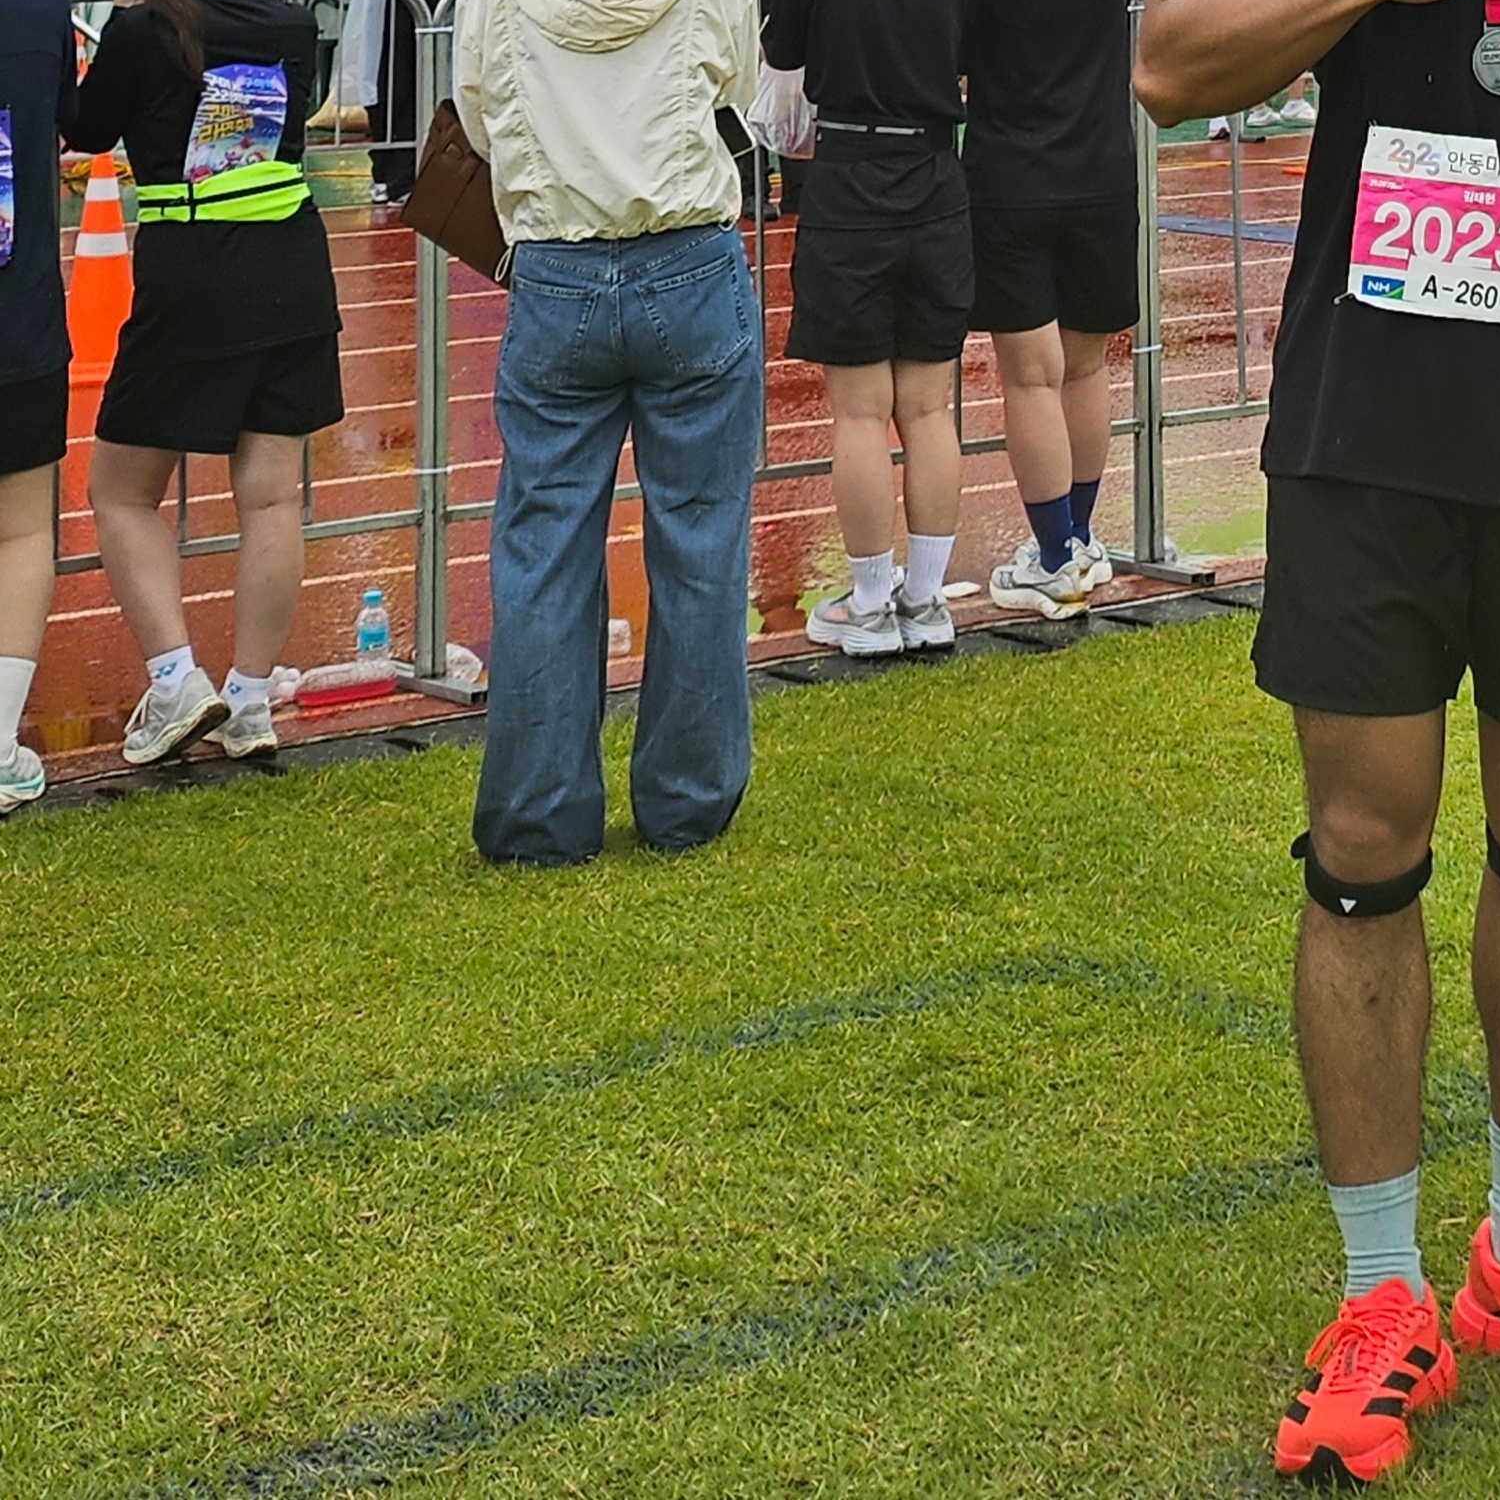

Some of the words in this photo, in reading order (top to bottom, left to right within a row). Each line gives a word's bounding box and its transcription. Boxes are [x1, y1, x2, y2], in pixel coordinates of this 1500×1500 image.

[1387, 138, 1441, 177] 2025
[1366, 278, 1391, 293] NH
[1421, 274, 1499, 310] A-260
